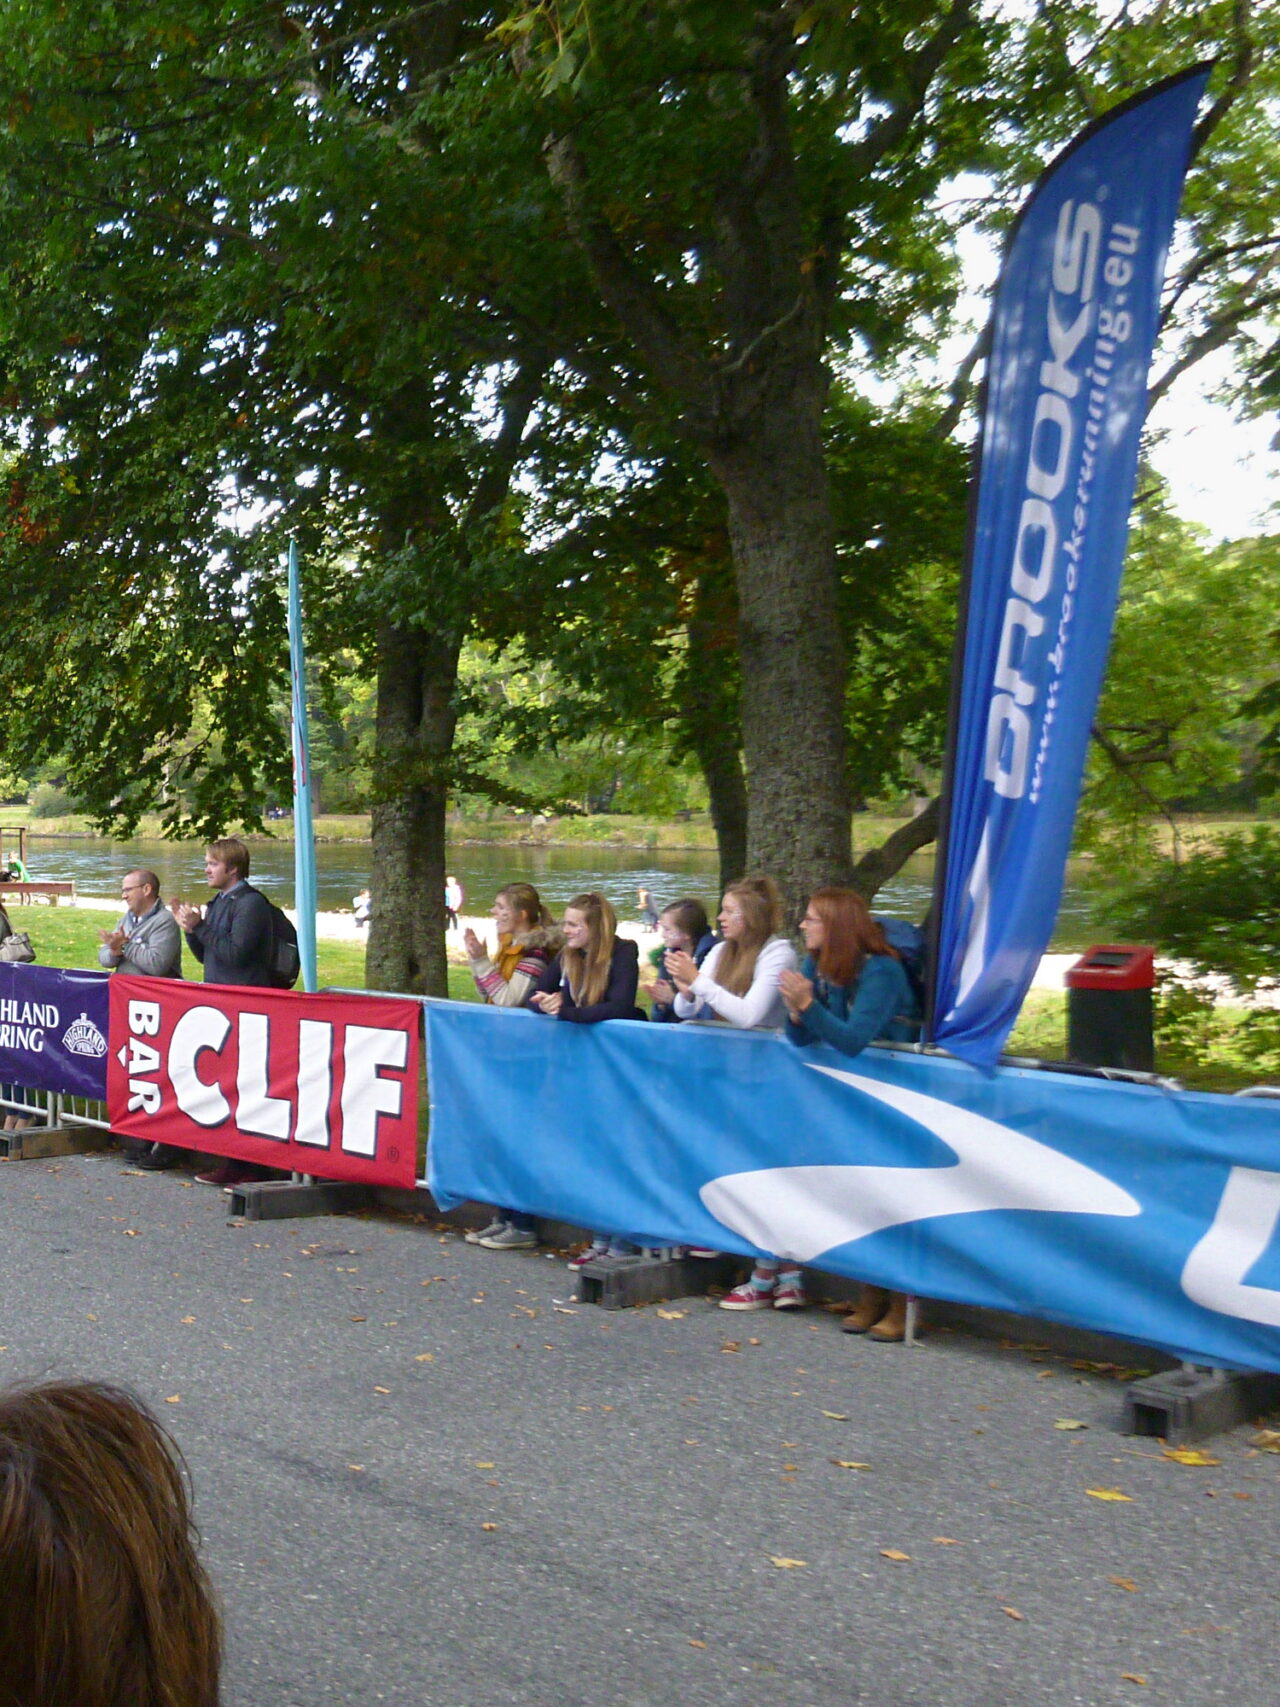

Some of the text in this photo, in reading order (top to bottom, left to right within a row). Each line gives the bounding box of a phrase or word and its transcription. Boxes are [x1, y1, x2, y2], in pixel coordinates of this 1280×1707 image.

[984, 199, 1102, 799] BROOKS
[64, 1025, 106, 1054] HIGHLAND
[128, 999, 161, 1115] BAR
[168, 1005, 408, 1160] CLIF
